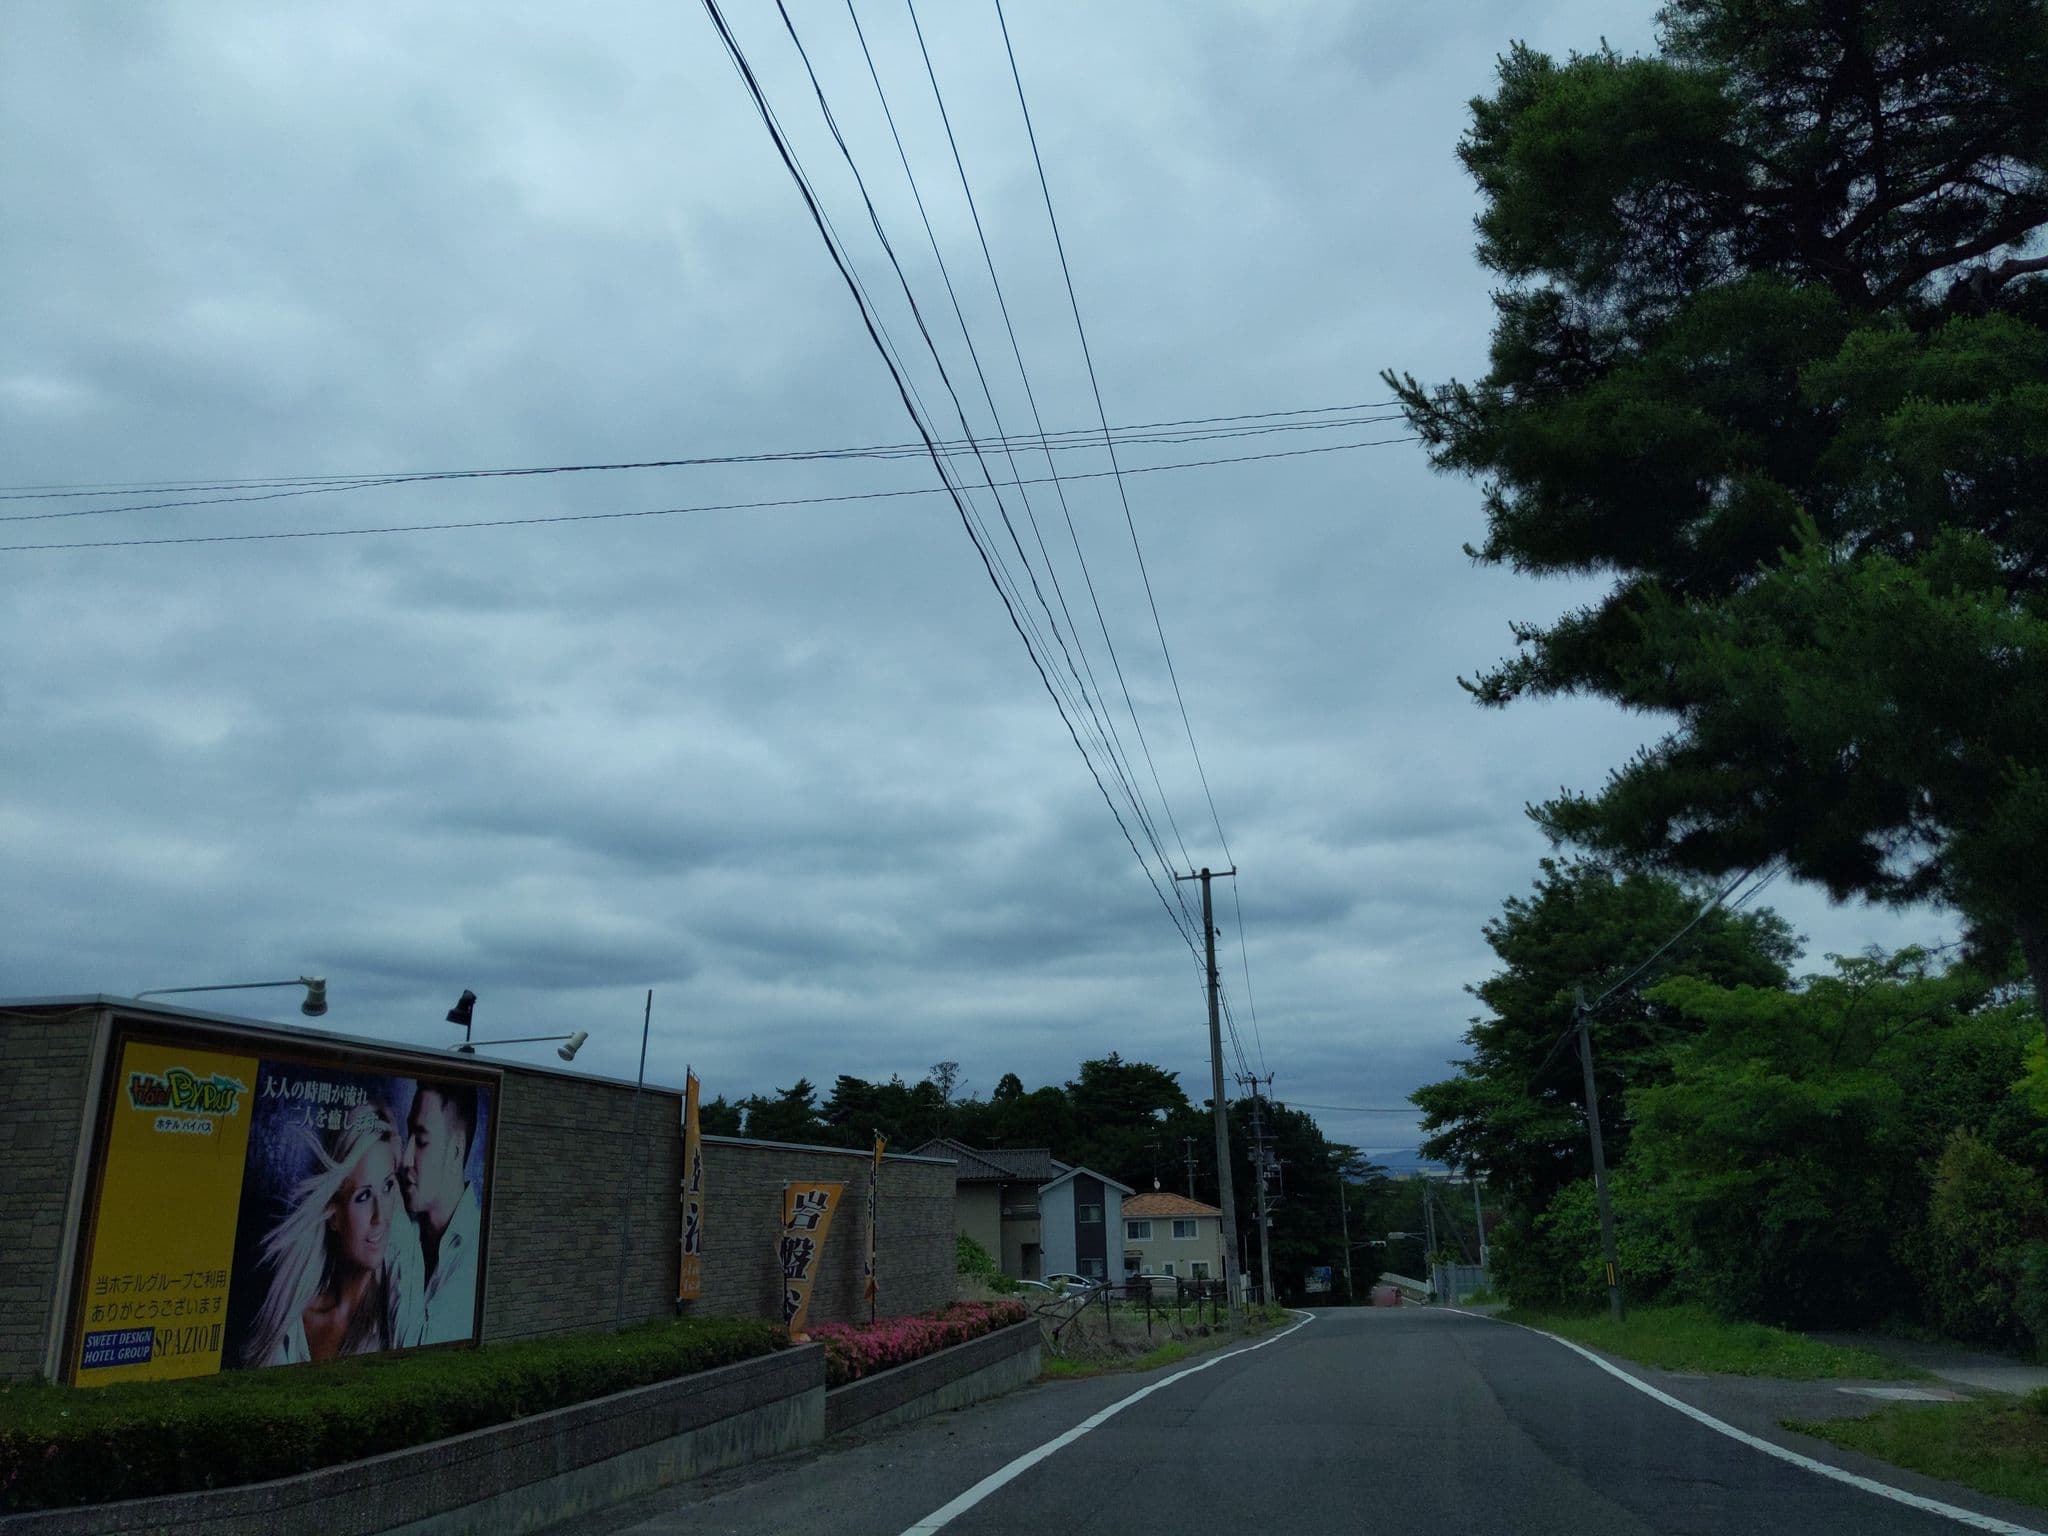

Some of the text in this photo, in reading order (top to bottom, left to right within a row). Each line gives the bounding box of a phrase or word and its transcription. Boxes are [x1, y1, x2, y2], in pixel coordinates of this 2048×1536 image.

[261, 1075, 369, 1106] 大人の時間が流れ
[156, 1118, 179, 1129] ホテル
[95, 1270, 227, 1295] 当ホテルグループご利用
[92, 1296, 222, 1323] ありがとうございます
[86, 1330, 152, 1348] SWEET DESIGN
[154, 1326, 208, 1357] SPAZIO
[84, 1346, 150, 1363] HOTEL GROUP
